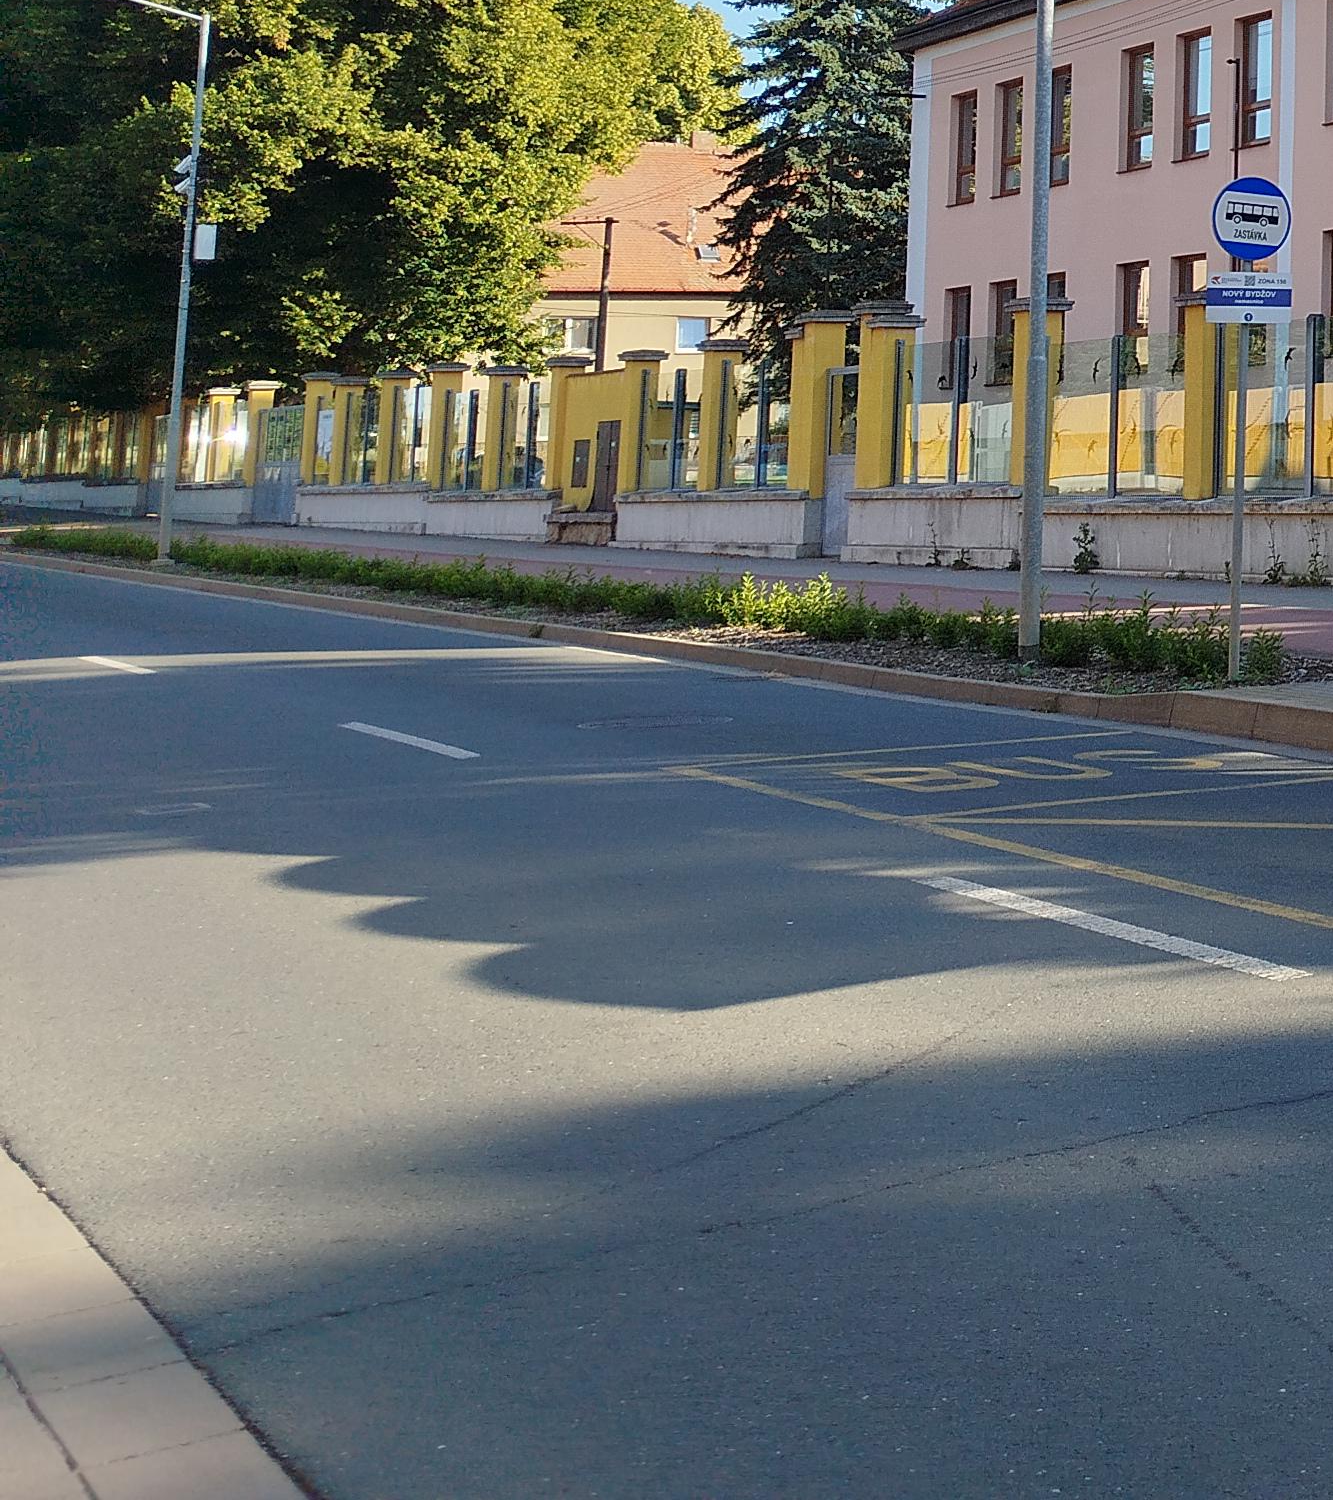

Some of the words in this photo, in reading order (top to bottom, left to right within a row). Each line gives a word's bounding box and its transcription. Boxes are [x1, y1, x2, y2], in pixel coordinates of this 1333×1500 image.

[1233, 229, 1267, 241] ZASTÁVKA
[1245, 290, 1277, 298] BYDŽOV
[831, 749, 1224, 793] BUS
